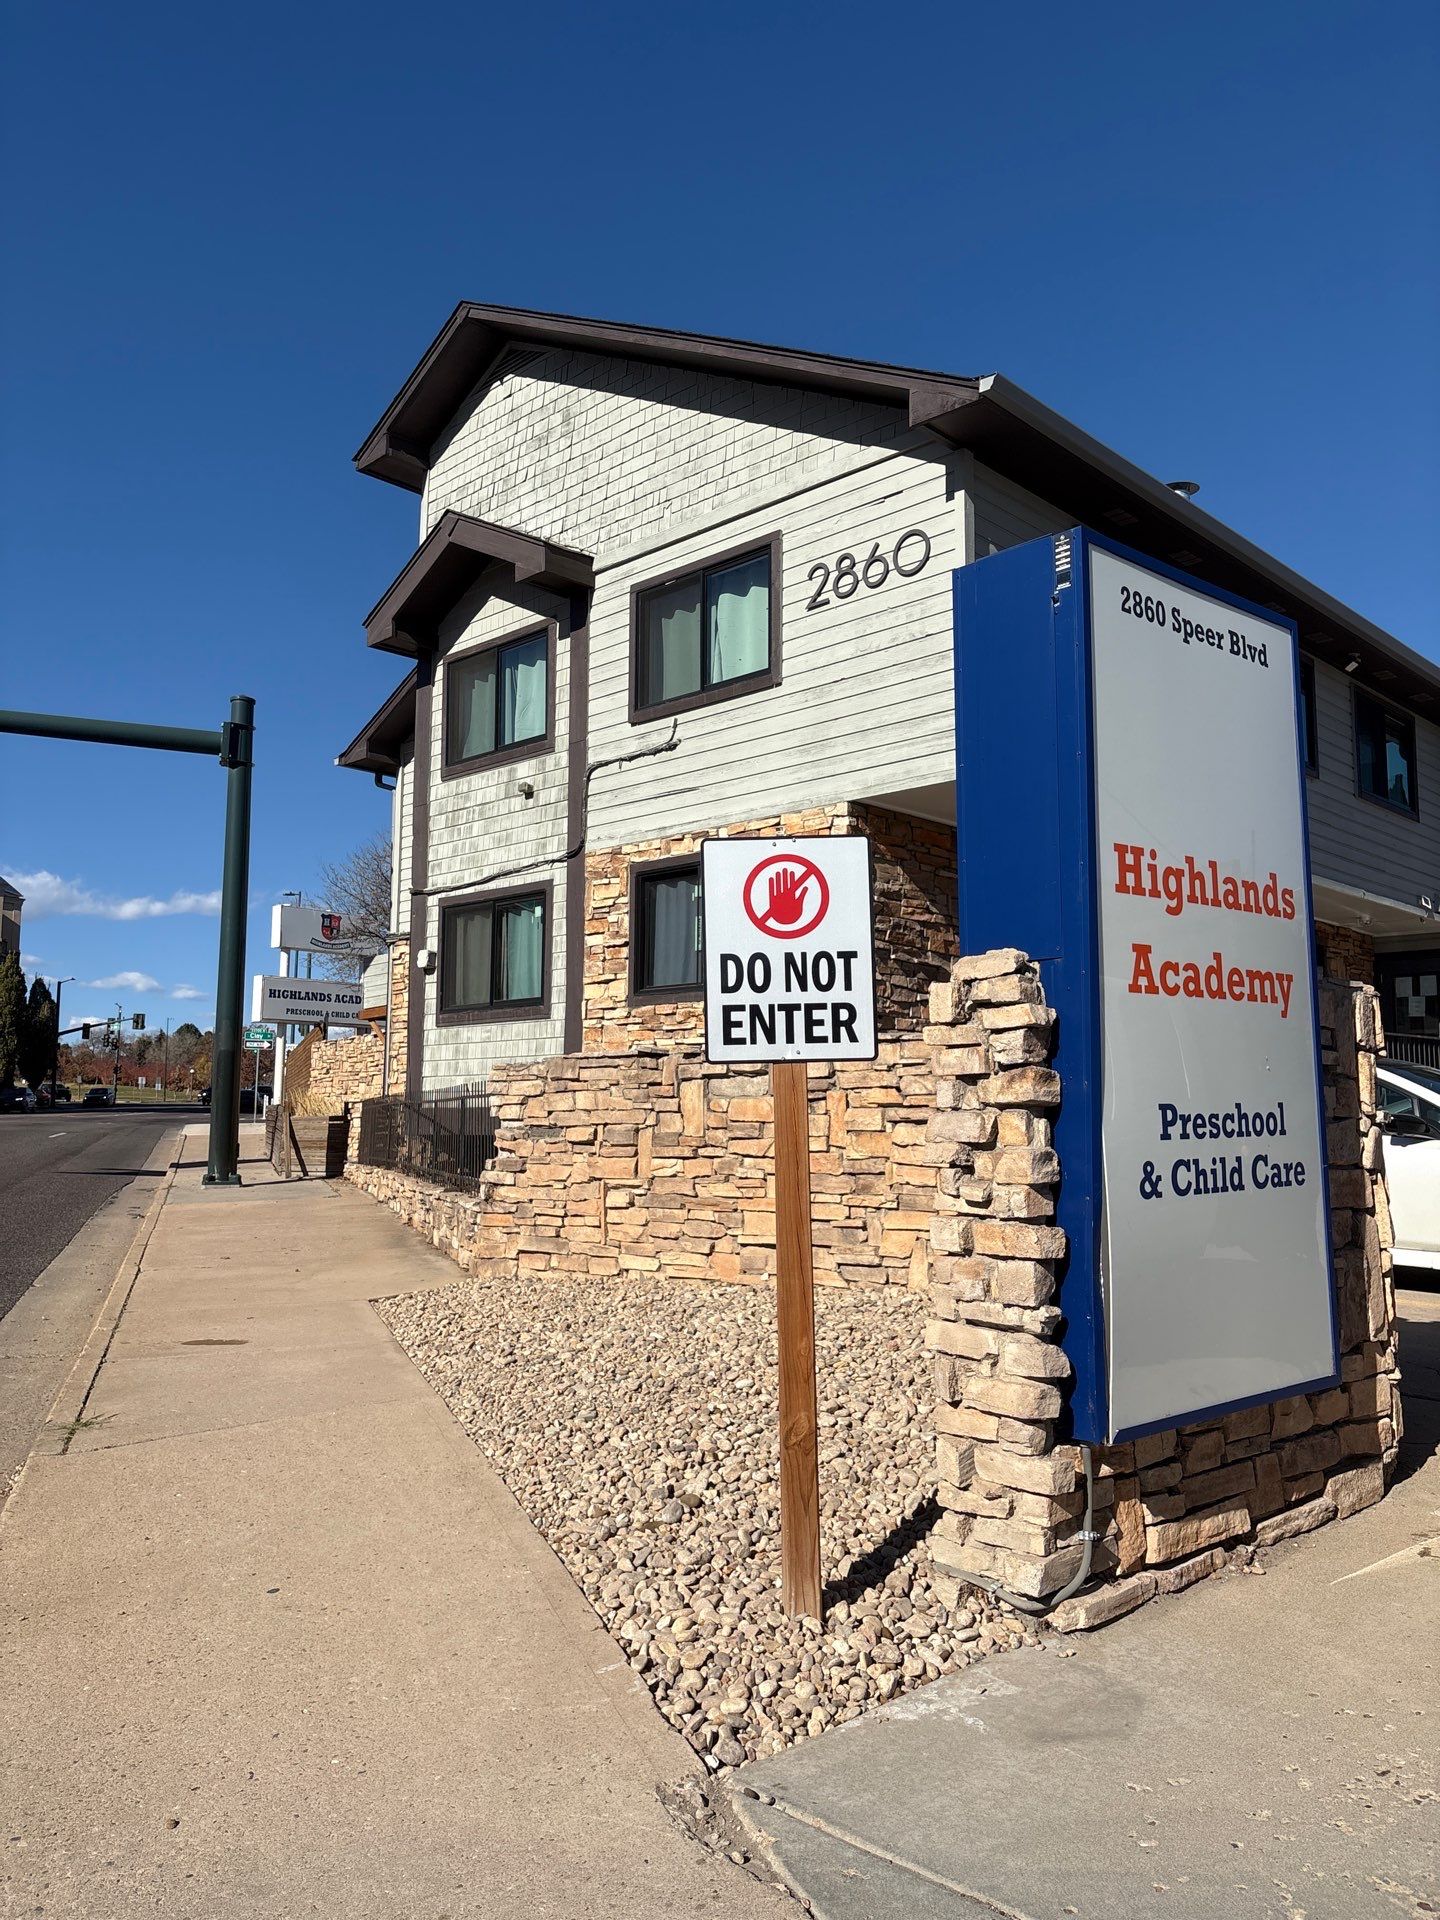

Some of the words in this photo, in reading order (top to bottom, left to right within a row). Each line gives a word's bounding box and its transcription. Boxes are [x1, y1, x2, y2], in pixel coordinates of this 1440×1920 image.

[805, 529, 931, 612] 2860
[1120, 586, 1166, 627] 2860
[1171, 607, 1224, 650] Speer
[1228, 629, 1269, 668] Blvd
[1113, 842, 1296, 920] Highlands
[720, 952, 772, 994] DO
[784, 950, 858, 992] NOT
[1128, 943, 1293, 1019] Academy
[268, 988, 332, 1003] HIGHLANDS
[334, 993, 362, 1005] ACAD
[285, 1007, 324, 1017] PRESCHOOL
[331, 1011, 350, 1019] CHILD
[722, 1002, 860, 1046] ENTER
[1158, 1102, 1287, 1141] Preschool
[1139, 1160, 1163, 1201] &
[1171, 1156, 1245, 1196] Child
[1251, 1154, 1306, 1190] Care
